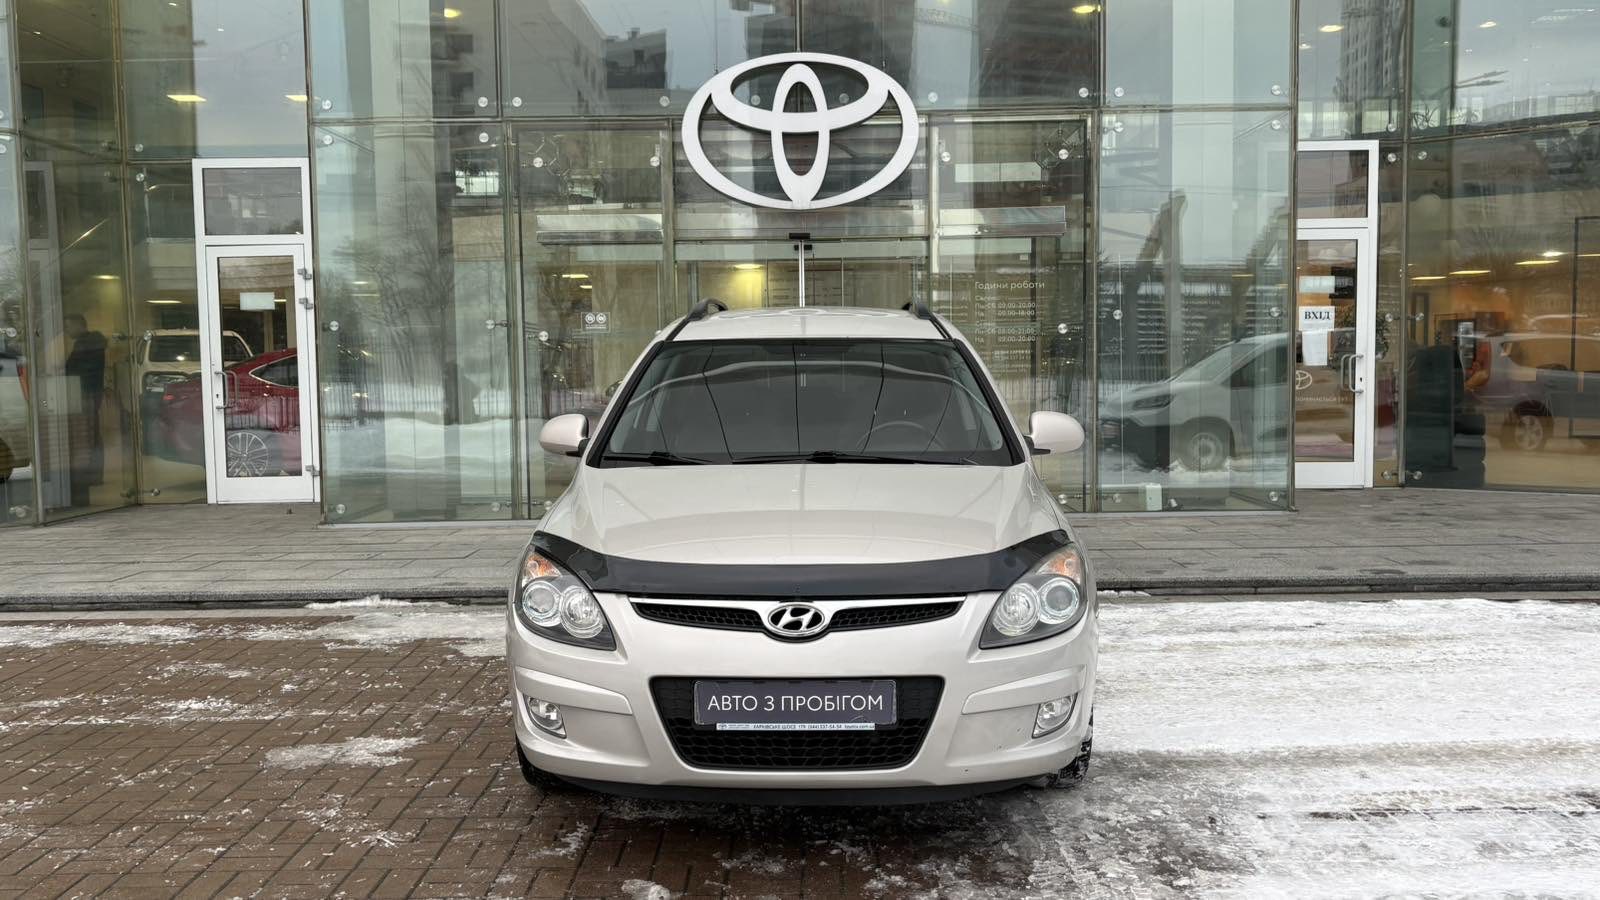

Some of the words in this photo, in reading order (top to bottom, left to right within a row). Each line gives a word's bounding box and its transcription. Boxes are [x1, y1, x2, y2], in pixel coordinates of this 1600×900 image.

[974, 281, 1009, 290] Години
[1304, 311, 1331, 320] ВХІД
[707, 695, 758, 711] АВТО
[763, 695, 775, 711] З
[781, 695, 884, 711] ПРОБІГОМ
